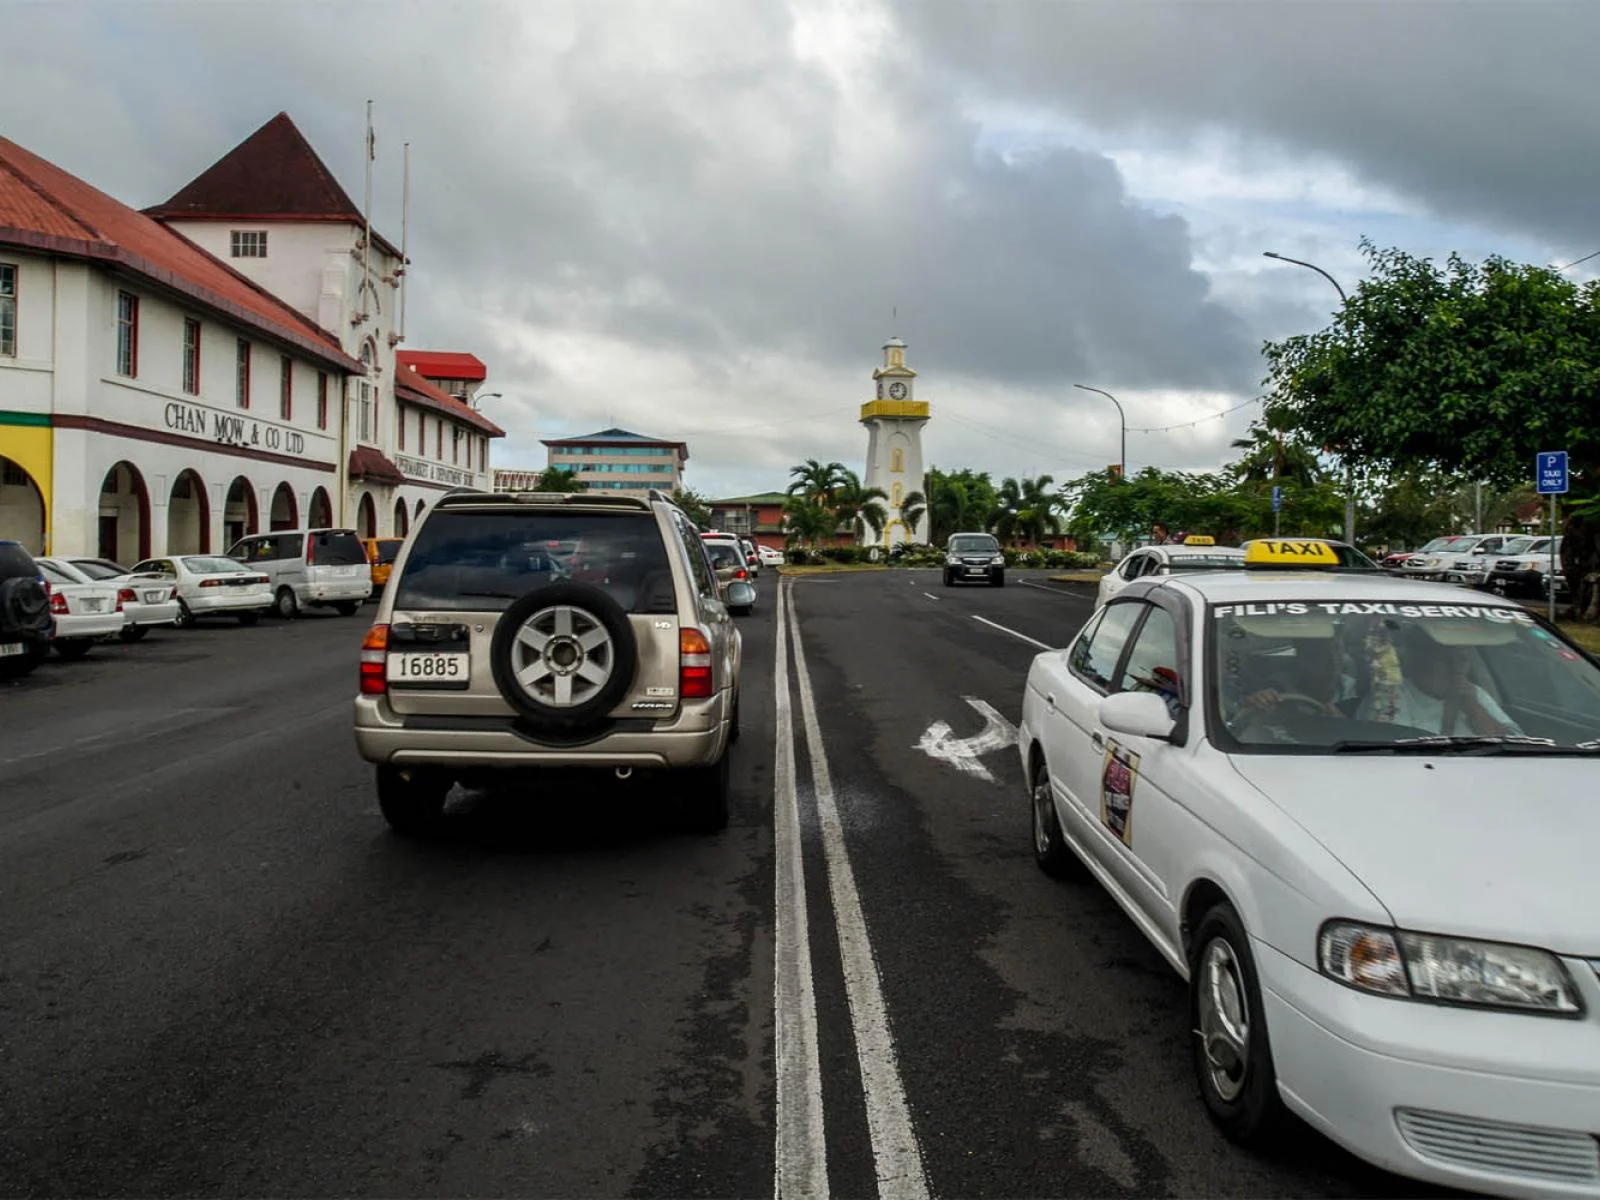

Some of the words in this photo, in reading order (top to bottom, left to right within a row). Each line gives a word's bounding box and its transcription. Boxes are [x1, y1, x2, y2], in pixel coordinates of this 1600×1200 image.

[165, 402, 206, 433] CHAN
[214, 413, 245, 441] MOW
[251, 423, 260, 445] &
[265, 427, 280, 449] CO
[286, 431, 304, 454] LTD
[1547, 456, 1557, 468] P
[1543, 470, 1562, 478] TAXI
[1542, 479, 1563, 487] ONLY
[1260, 541, 1324, 556] TAXI
[1213, 602, 1309, 619] FILI'S
[1317, 603, 1399, 614] TAXI
[1399, 605, 1536, 626] SERVICE
[401, 657, 459, 677] 16885
